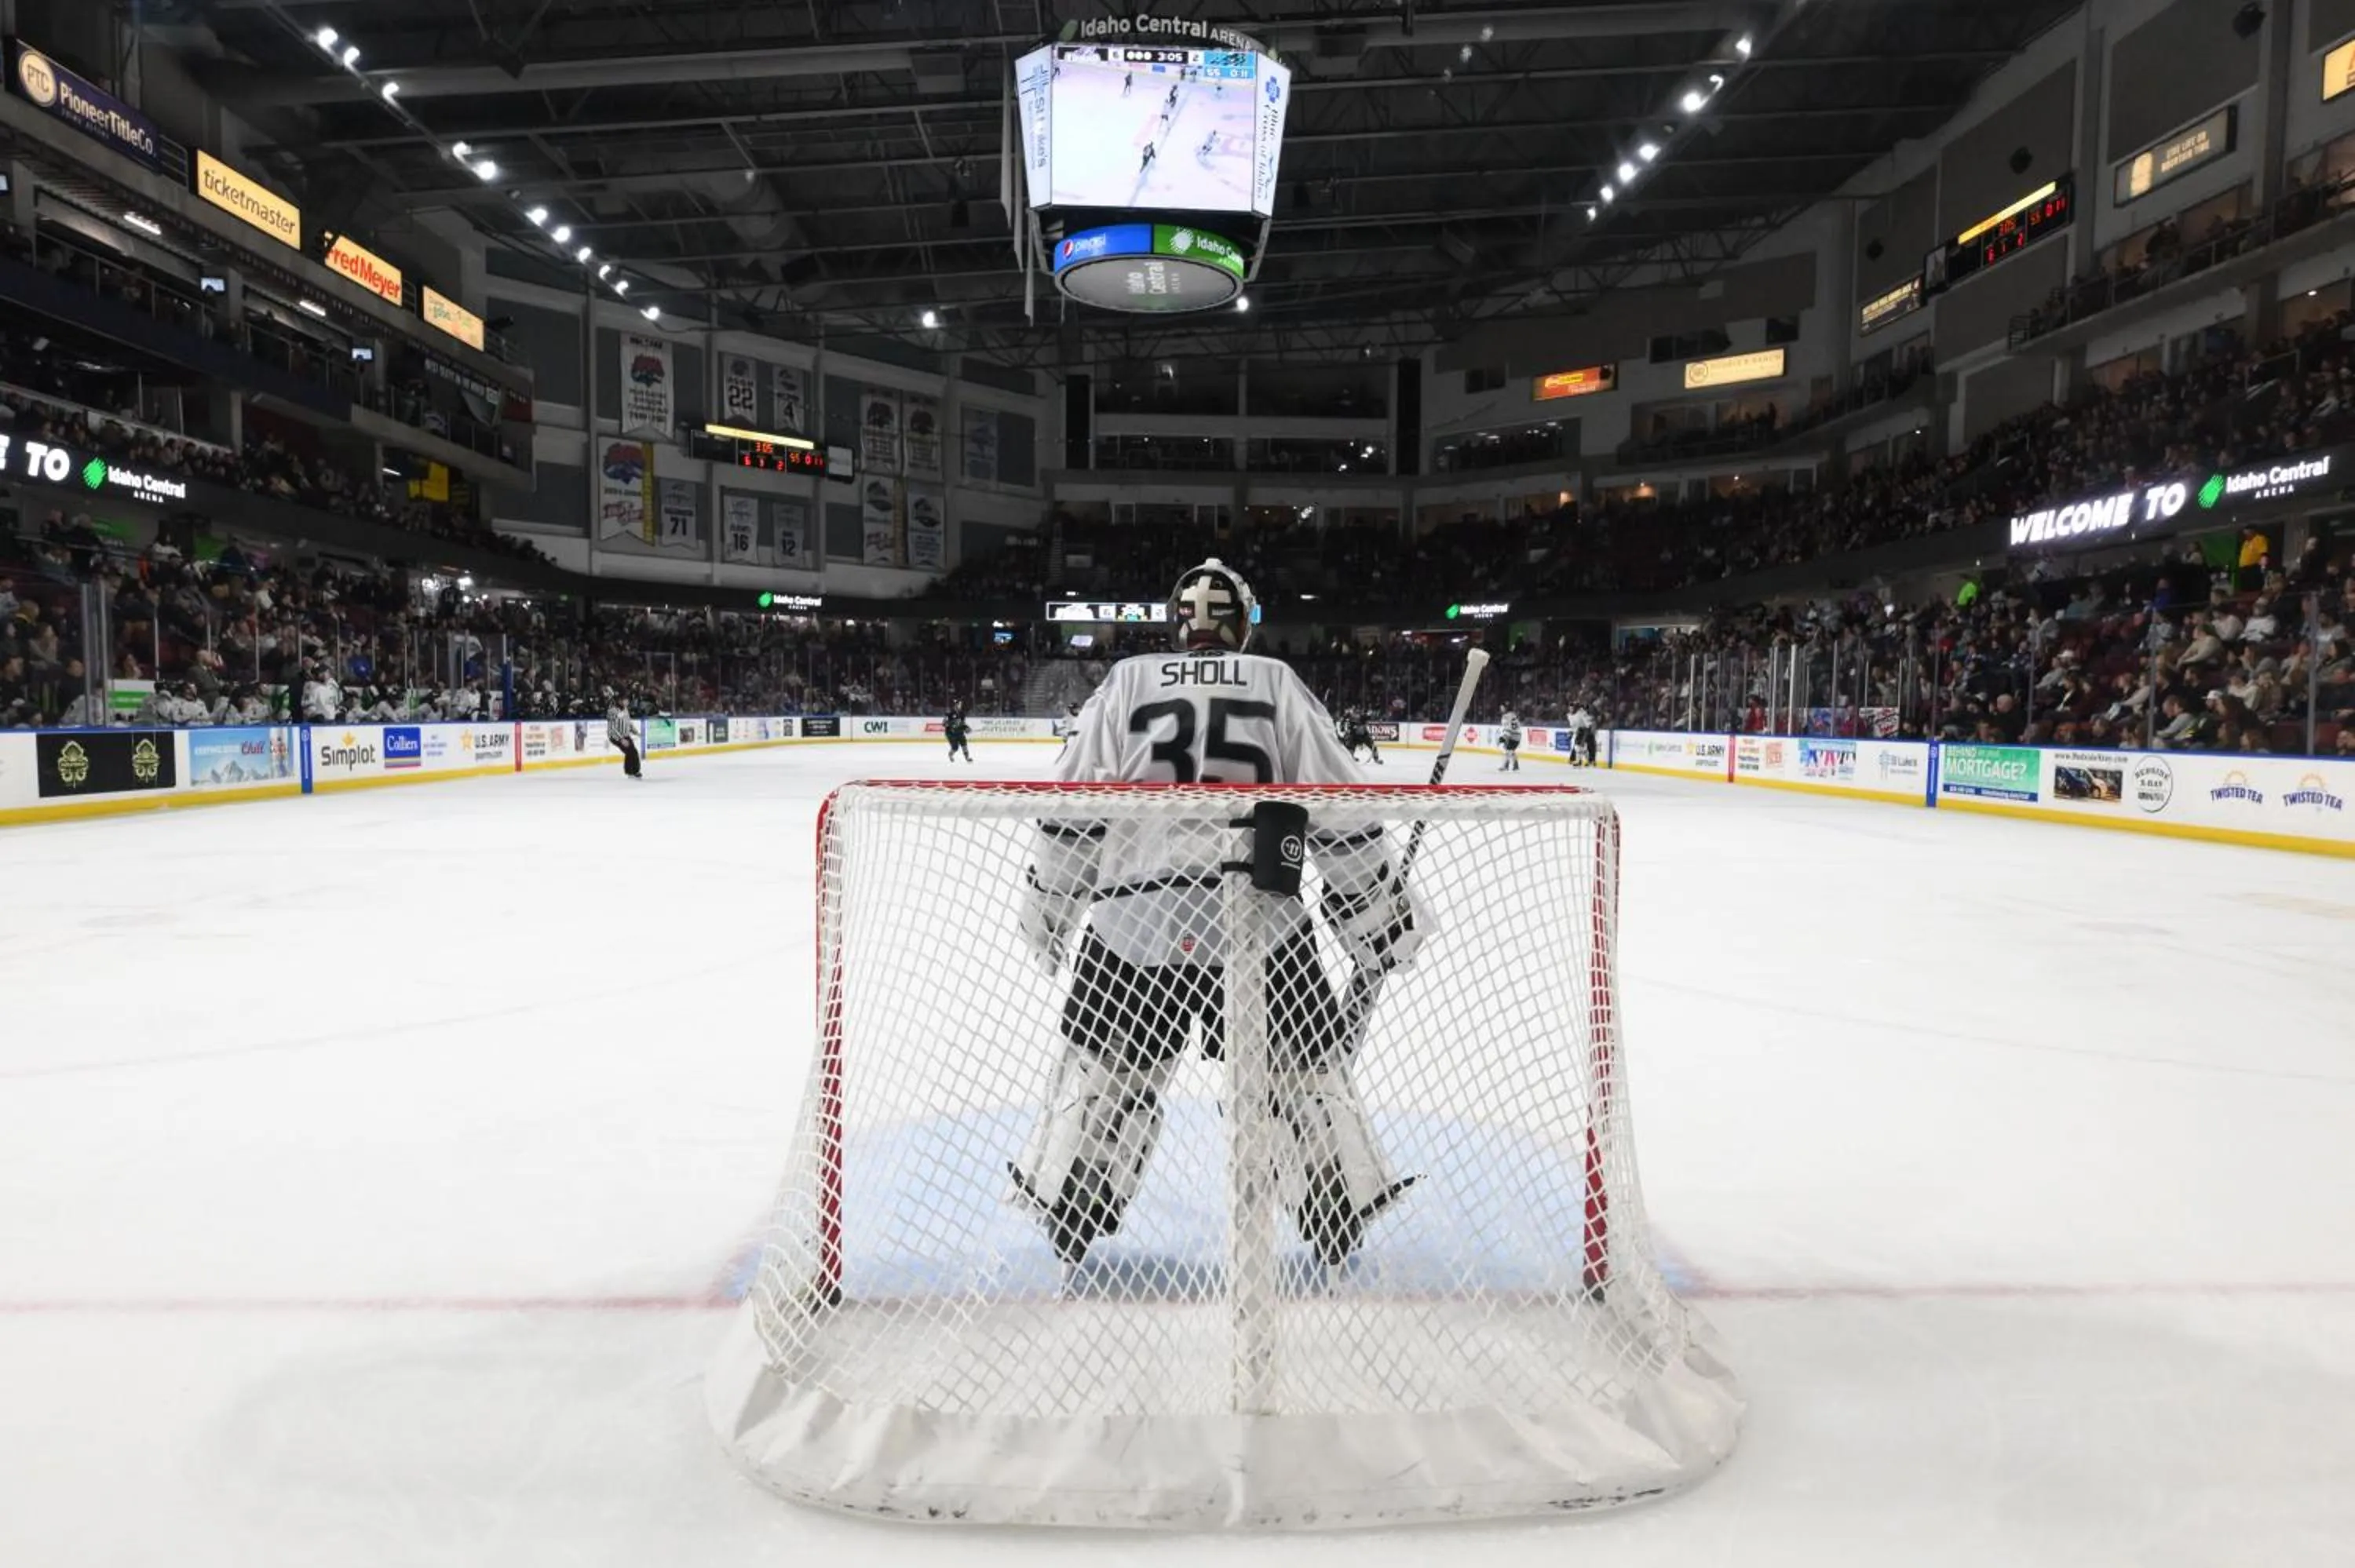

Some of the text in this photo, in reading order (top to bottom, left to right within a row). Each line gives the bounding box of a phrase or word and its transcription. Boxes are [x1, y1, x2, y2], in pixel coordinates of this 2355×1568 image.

[1080, 14, 1251, 49] Idaho Central ARENA
[27, 64, 49, 93] PTC
[203, 169, 295, 235] ticketmaster
[1196, 235, 1225, 255] Idaho
[729, 385, 753, 410] 22
[26, 441, 70, 481] TO
[2225, 455, 2331, 494] Idaho Central
[108, 465, 186, 498] Idaho Central
[670, 516, 687, 536] 71
[2010, 482, 2187, 545] WELCOME TO
[733, 533, 749, 551] 16
[1160, 660, 1247, 687] SHOLL
[864, 720, 889, 734] CWI
[1130, 698, 1277, 783] 35
[386, 735, 418, 751] Colliers
[321, 743, 376, 771] Simplot
[1944, 757, 2027, 780] MORTGAGE?
[2210, 787, 2263, 804] TWISTED TEA
[2282, 791, 2344, 811] TWISTED TEA
